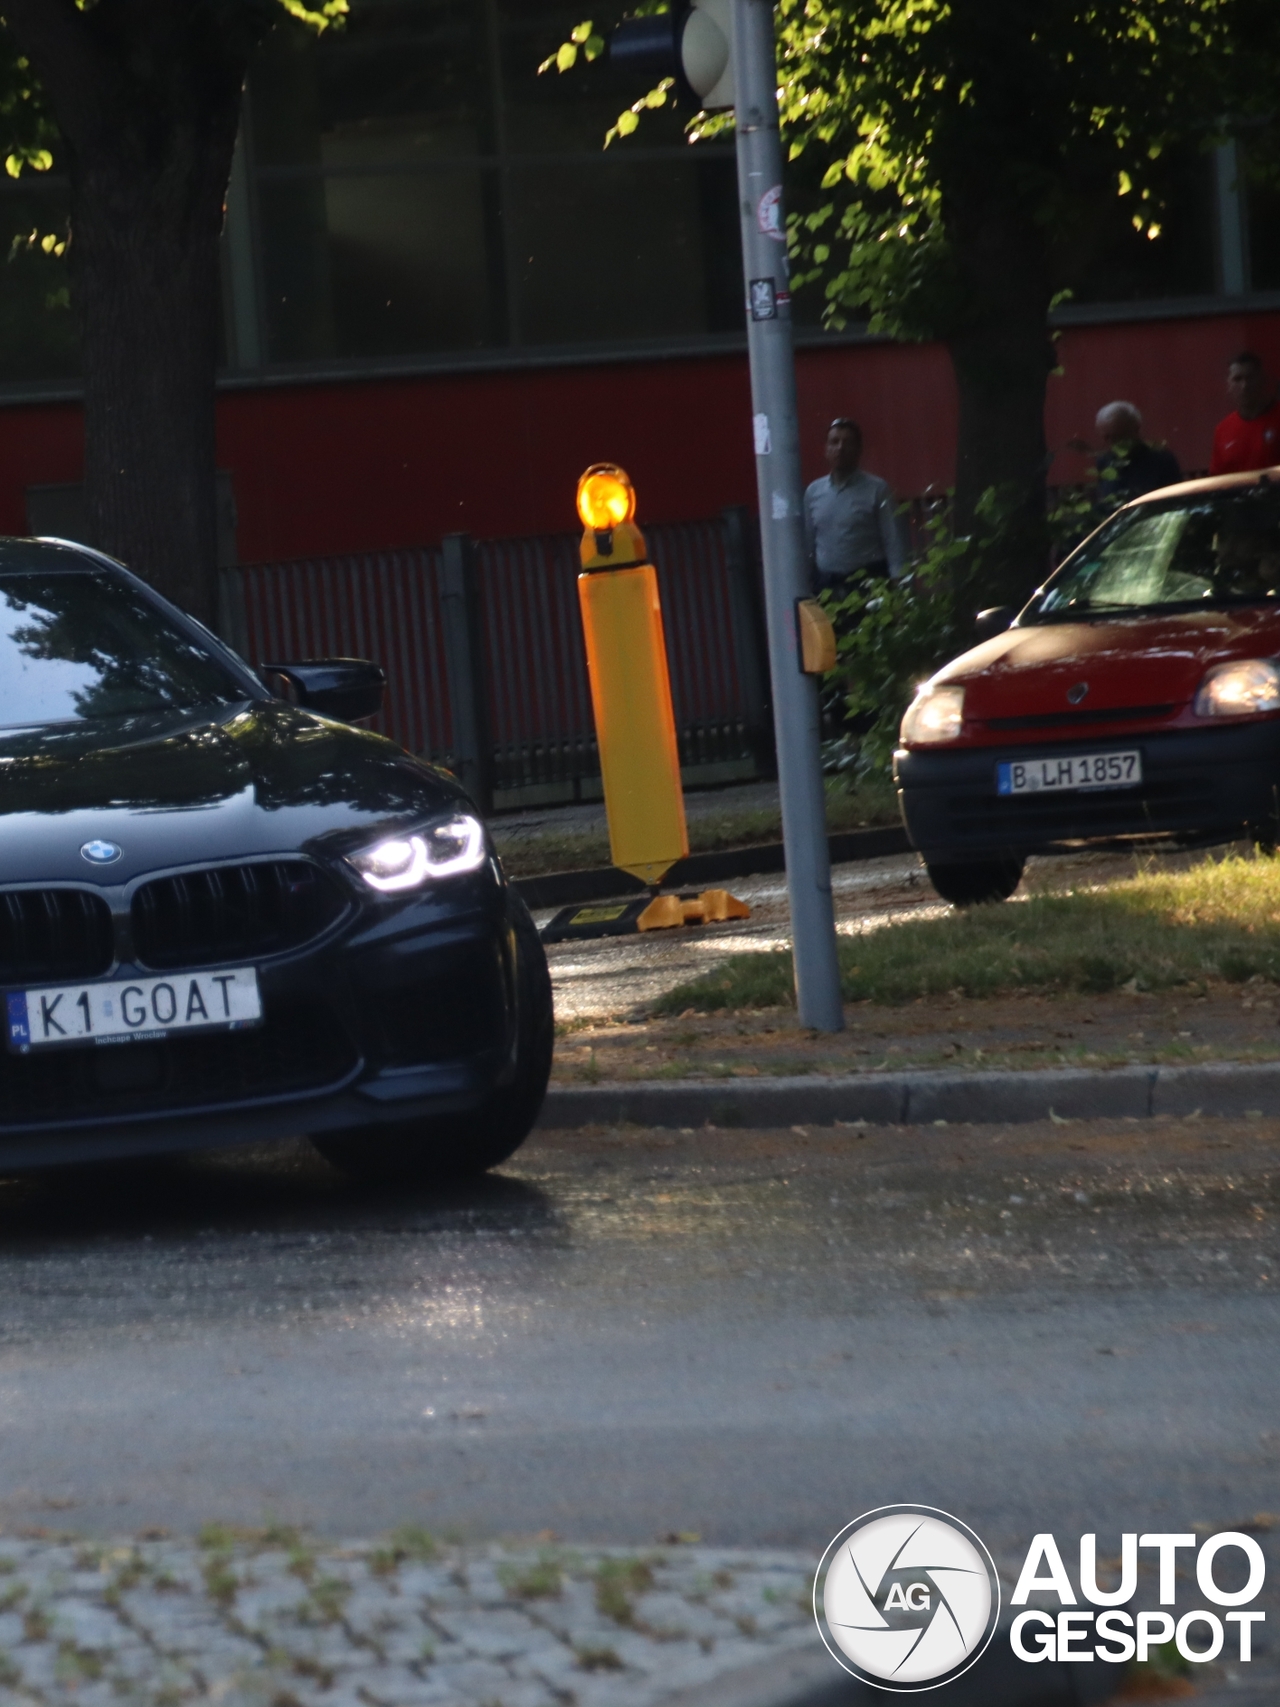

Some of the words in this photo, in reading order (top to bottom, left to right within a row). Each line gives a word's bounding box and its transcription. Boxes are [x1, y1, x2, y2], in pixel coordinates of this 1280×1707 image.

[1013, 765, 1026, 788] B
[40, 991, 92, 1037] K1
[120, 975, 236, 1027] GOAT
[11, 1025, 27, 1037] PL
